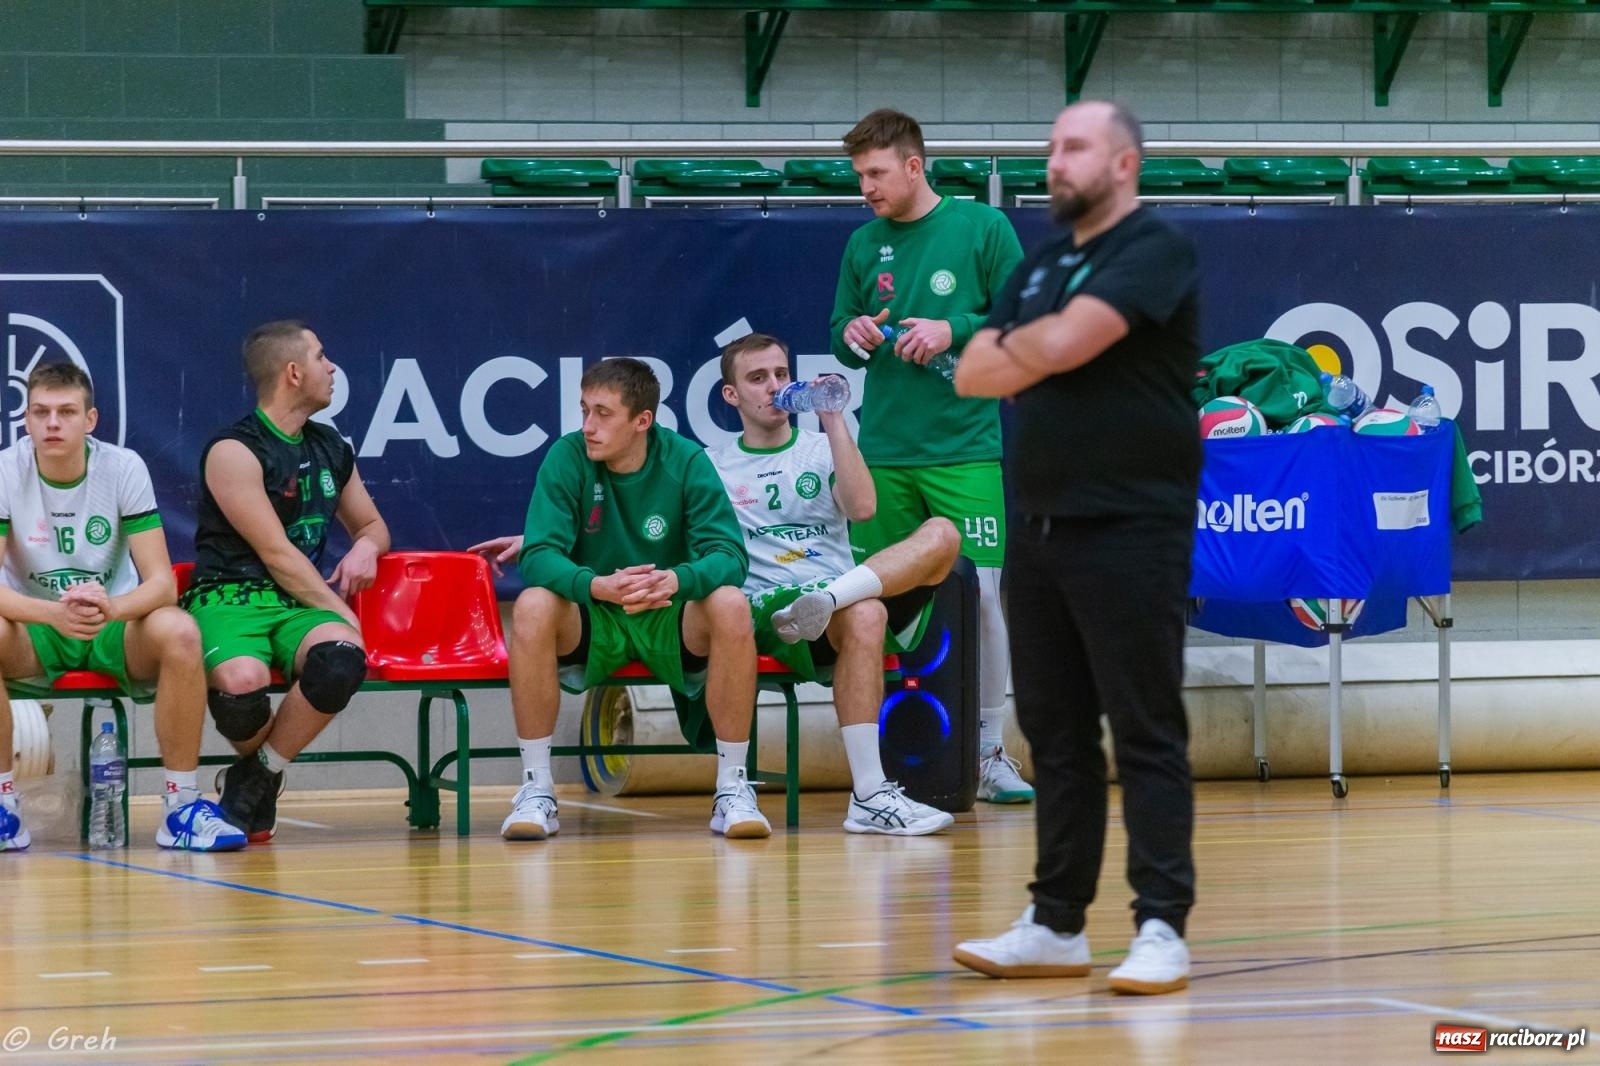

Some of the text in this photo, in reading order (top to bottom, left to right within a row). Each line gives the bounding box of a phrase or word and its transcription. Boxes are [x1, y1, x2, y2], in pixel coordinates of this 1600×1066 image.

[878, 273, 894, 292] R
[1213, 425, 1246, 437] molten
[1467, 437, 1600, 484] CIBÓR
[765, 483, 782, 510] 2
[53, 526, 75, 554] 16
[965, 517, 997, 547] 49
